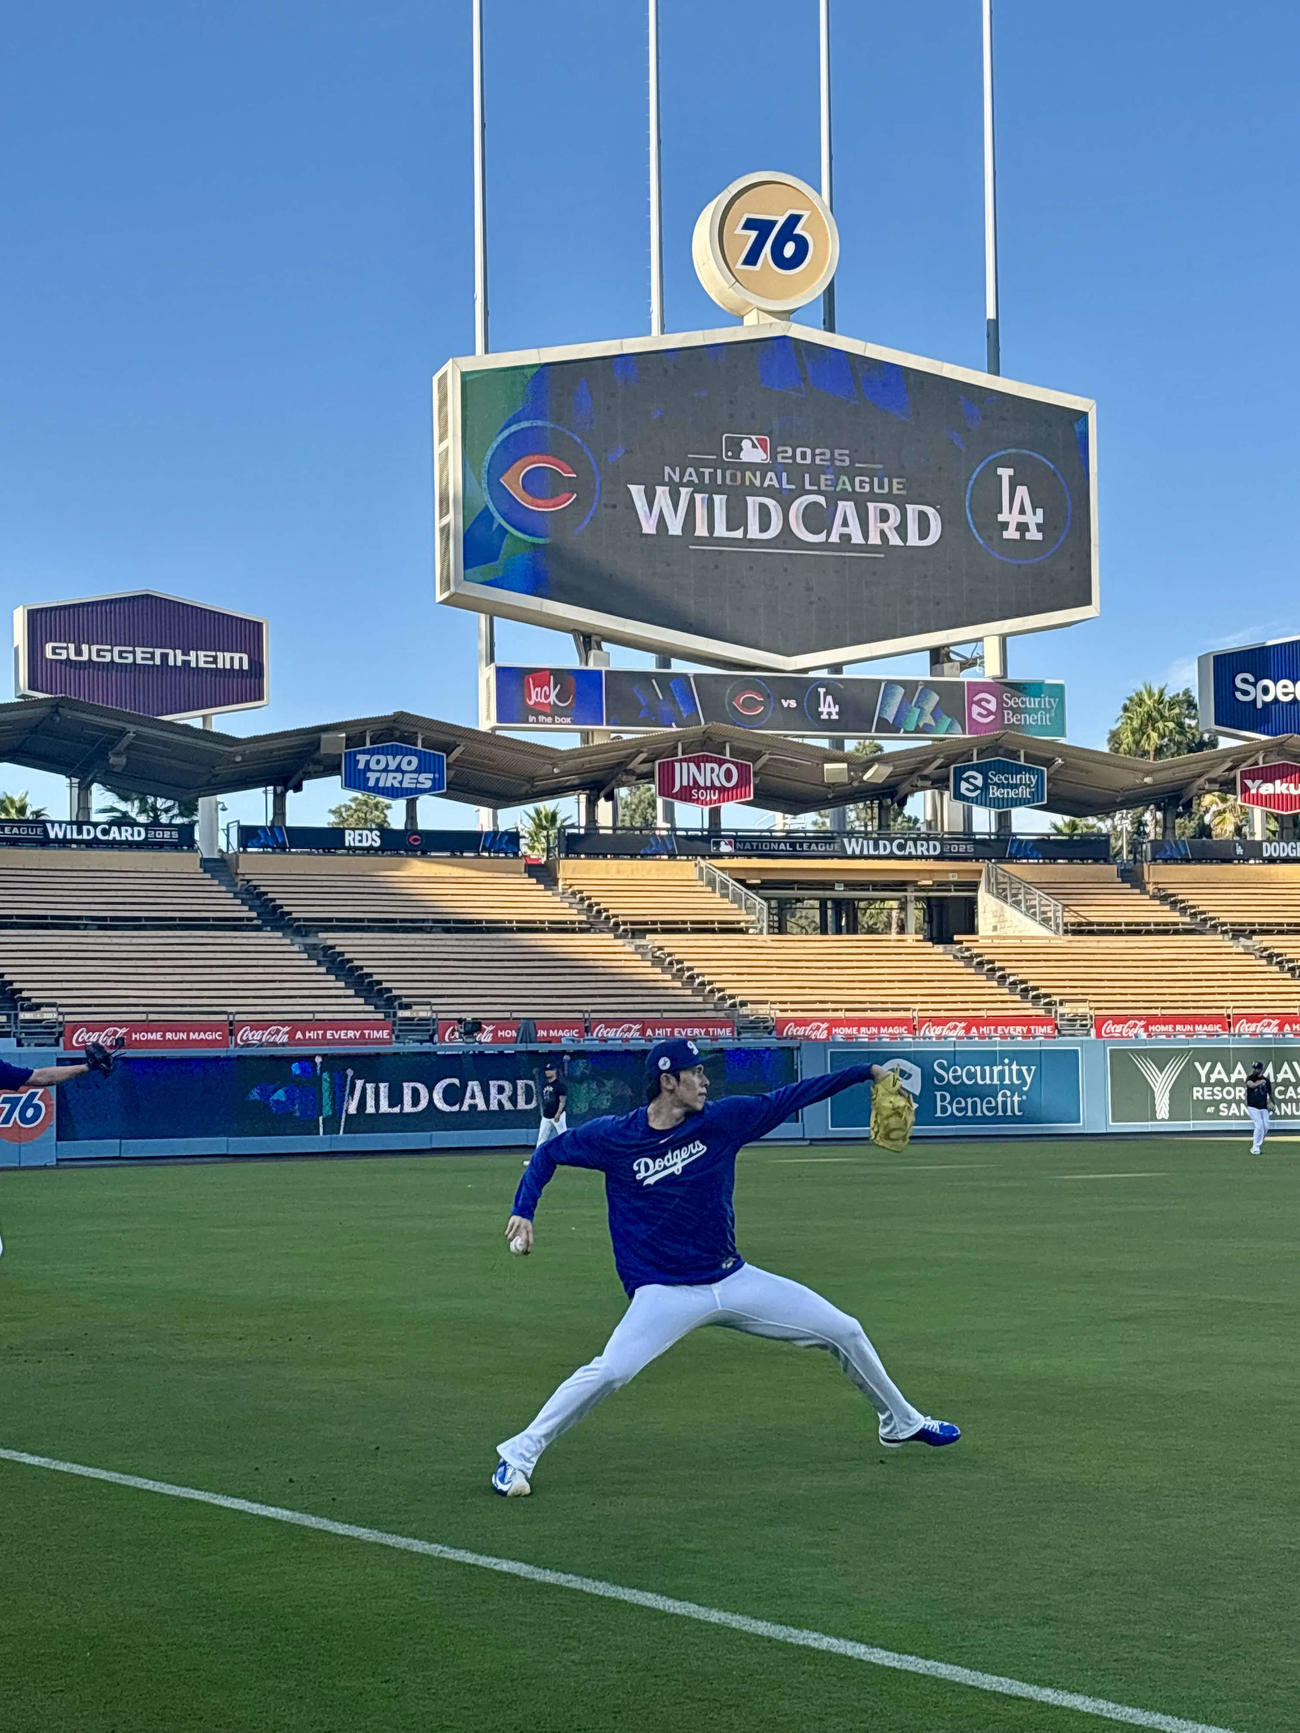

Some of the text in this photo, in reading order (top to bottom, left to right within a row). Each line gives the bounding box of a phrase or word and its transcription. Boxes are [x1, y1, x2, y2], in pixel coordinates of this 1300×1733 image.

[736, 209, 812, 274] 76
[776, 446, 850, 467] 2025
[664, 465, 907, 495] NATIONAL LEAGUE
[997, 467, 1043, 542] LA
[45, 641, 249, 671] GUGGENHEIM
[525, 675, 574, 707] Jack
[781, 698, 797, 708] vs
[818, 687, 839, 719] LA
[1002, 692, 1059, 714] Security
[528, 714, 571, 724] in the box
[1003, 710, 1052, 726] Benefit
[356, 754, 418, 771] TOYO
[366, 772, 434, 789] TIRES
[671, 762, 739, 794] JINRO
[988, 770, 1038, 788] Security
[1243, 778, 1300, 795] Yaku
[691, 788, 719, 802] SOJU
[989, 785, 1032, 799] Benefit
[148, 830, 179, 839] 2025
[345, 829, 381, 847] REDS
[736, 841, 794, 851] NATIONAL
[796, 843, 840, 852] LEAGUE
[943, 844, 974, 853] 2025
[132, 1032, 163, 1040] HOME
[166, 1032, 187, 1040] RUN
[189, 1031, 223, 1040] MAGIC
[295, 1031, 303, 1039] A
[305, 1031, 323, 1039] HIT
[327, 1030, 362, 1039] EVERY
[363, 1030, 390, 1039] TIME
[498, 1030, 517, 1038] HOM
[550, 1029, 579, 1037] MAGIC
[645, 1028, 653, 1036] A
[655, 1028, 672, 1036] HIT
[674, 1028, 706, 1036] EVERY
[708, 1027, 733, 1036] TIME
[832, 1026, 858, 1034] HOME
[860, 1026, 878, 1034] RUN
[880, 1026, 908, 1034] MAGIC
[970, 1026, 978, 1034] A
[980, 1025, 996, 1034] HIT
[997, 1025, 1028, 1034] EVERY
[1030, 1025, 1053, 1034] TIME
[1149, 1024, 1174, 1032] HOME
[1176, 1024, 1193, 1032] RUN
[1195, 1024, 1222, 1032] MAGIC
[1284, 1023, 1291, 1032] A
[933, 1058, 1037, 1091] Security
[1193, 1086, 1246, 1100] RESOR
[0, 1088, 46, 1129] 76
[934, 1090, 1023, 1117] Benefit
[1206, 1106, 1215, 1114] AT
[633, 1139, 707, 1187] Dodgers
